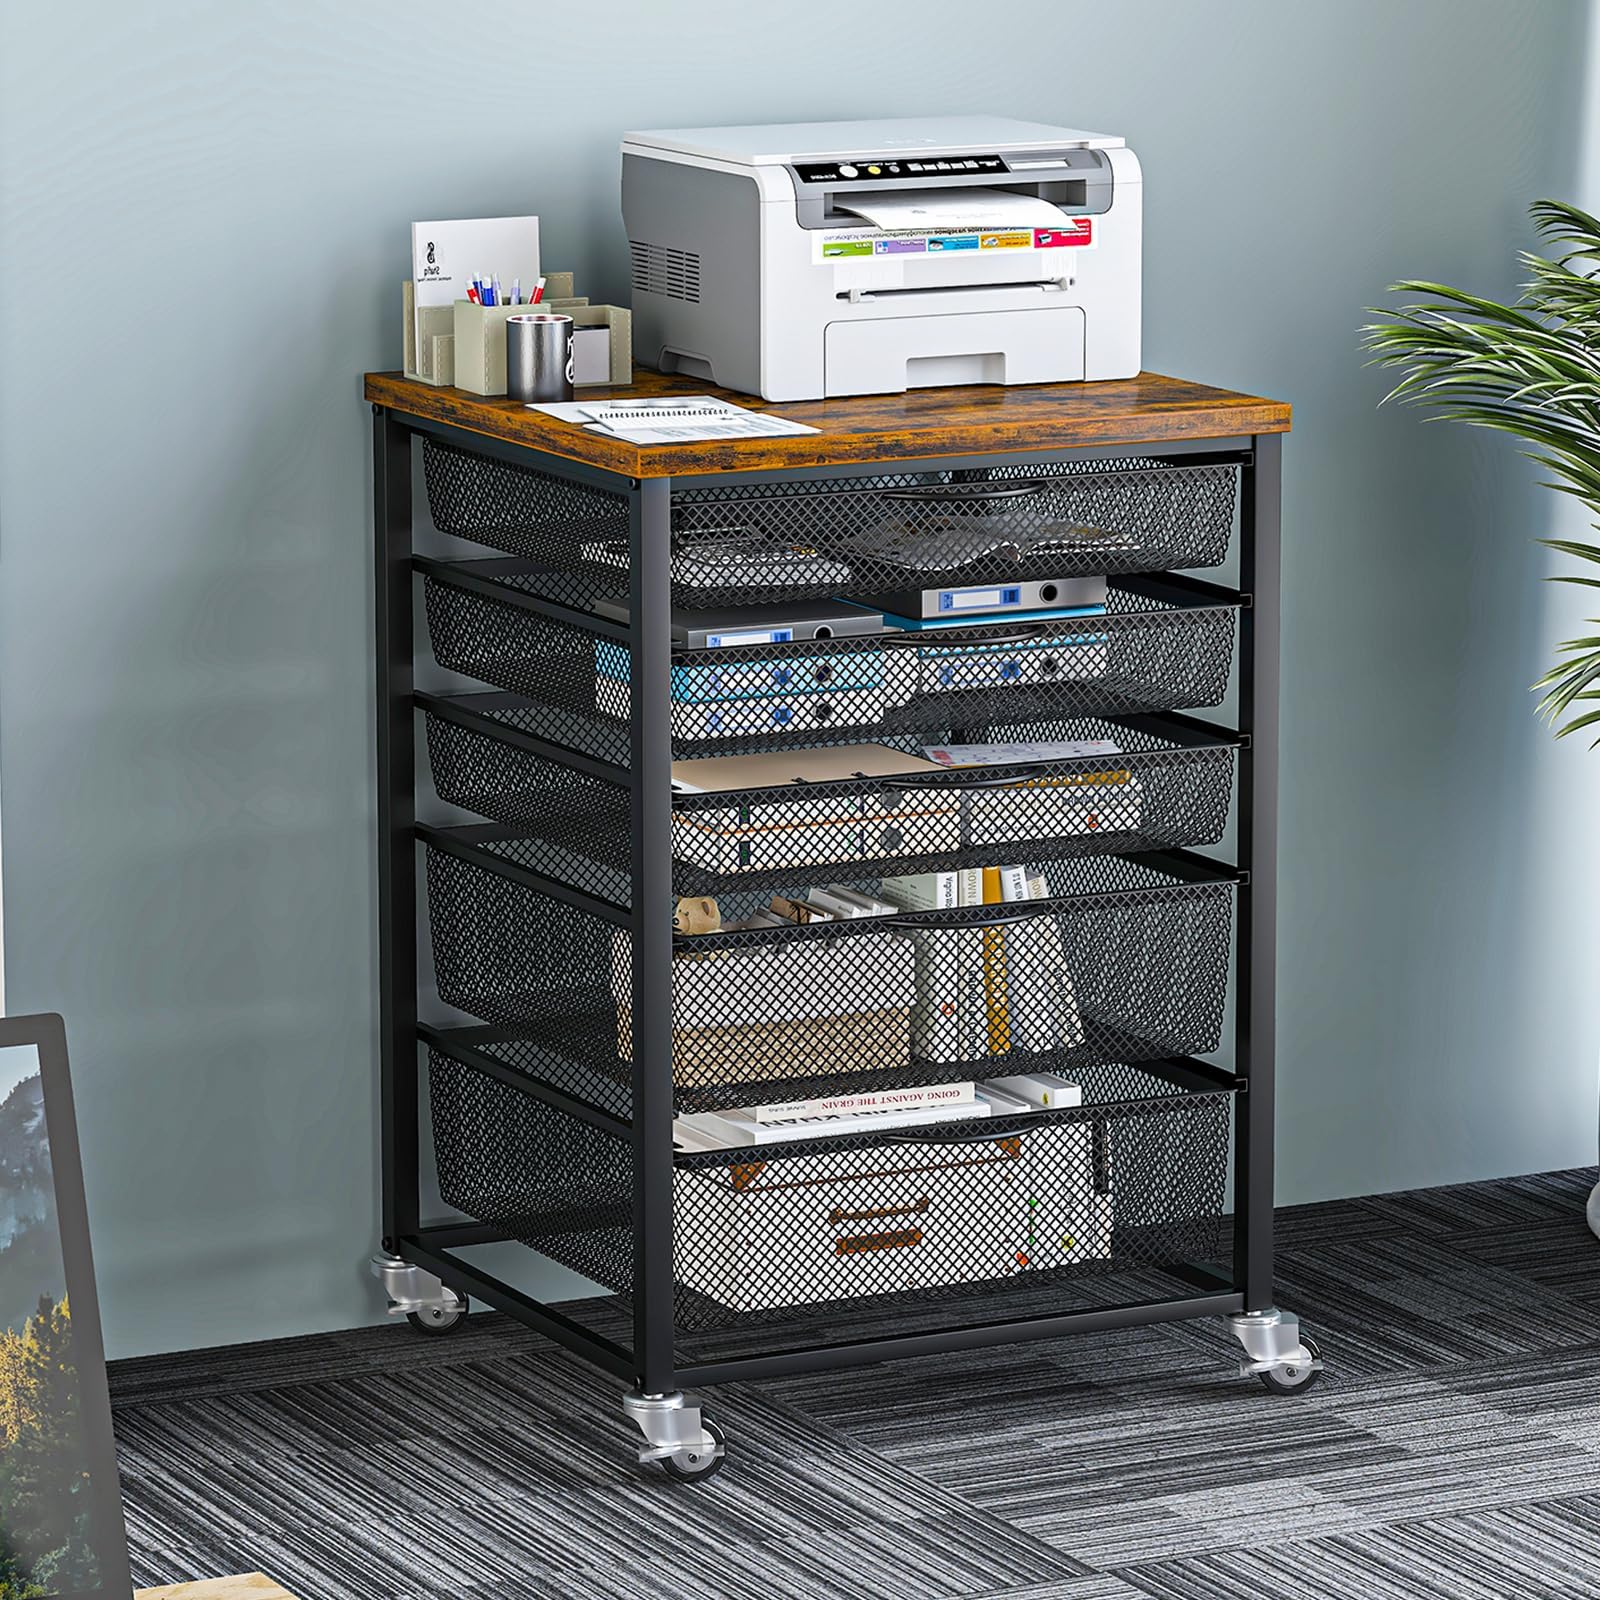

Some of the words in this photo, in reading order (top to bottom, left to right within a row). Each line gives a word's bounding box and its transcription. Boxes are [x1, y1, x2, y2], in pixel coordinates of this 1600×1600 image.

[879, 1092, 925, 1106] AGAINST
[927, 1089, 961, 1102] GOING
[821, 1099, 854, 1111] GRAIN
[857, 1097, 877, 1108] THE
